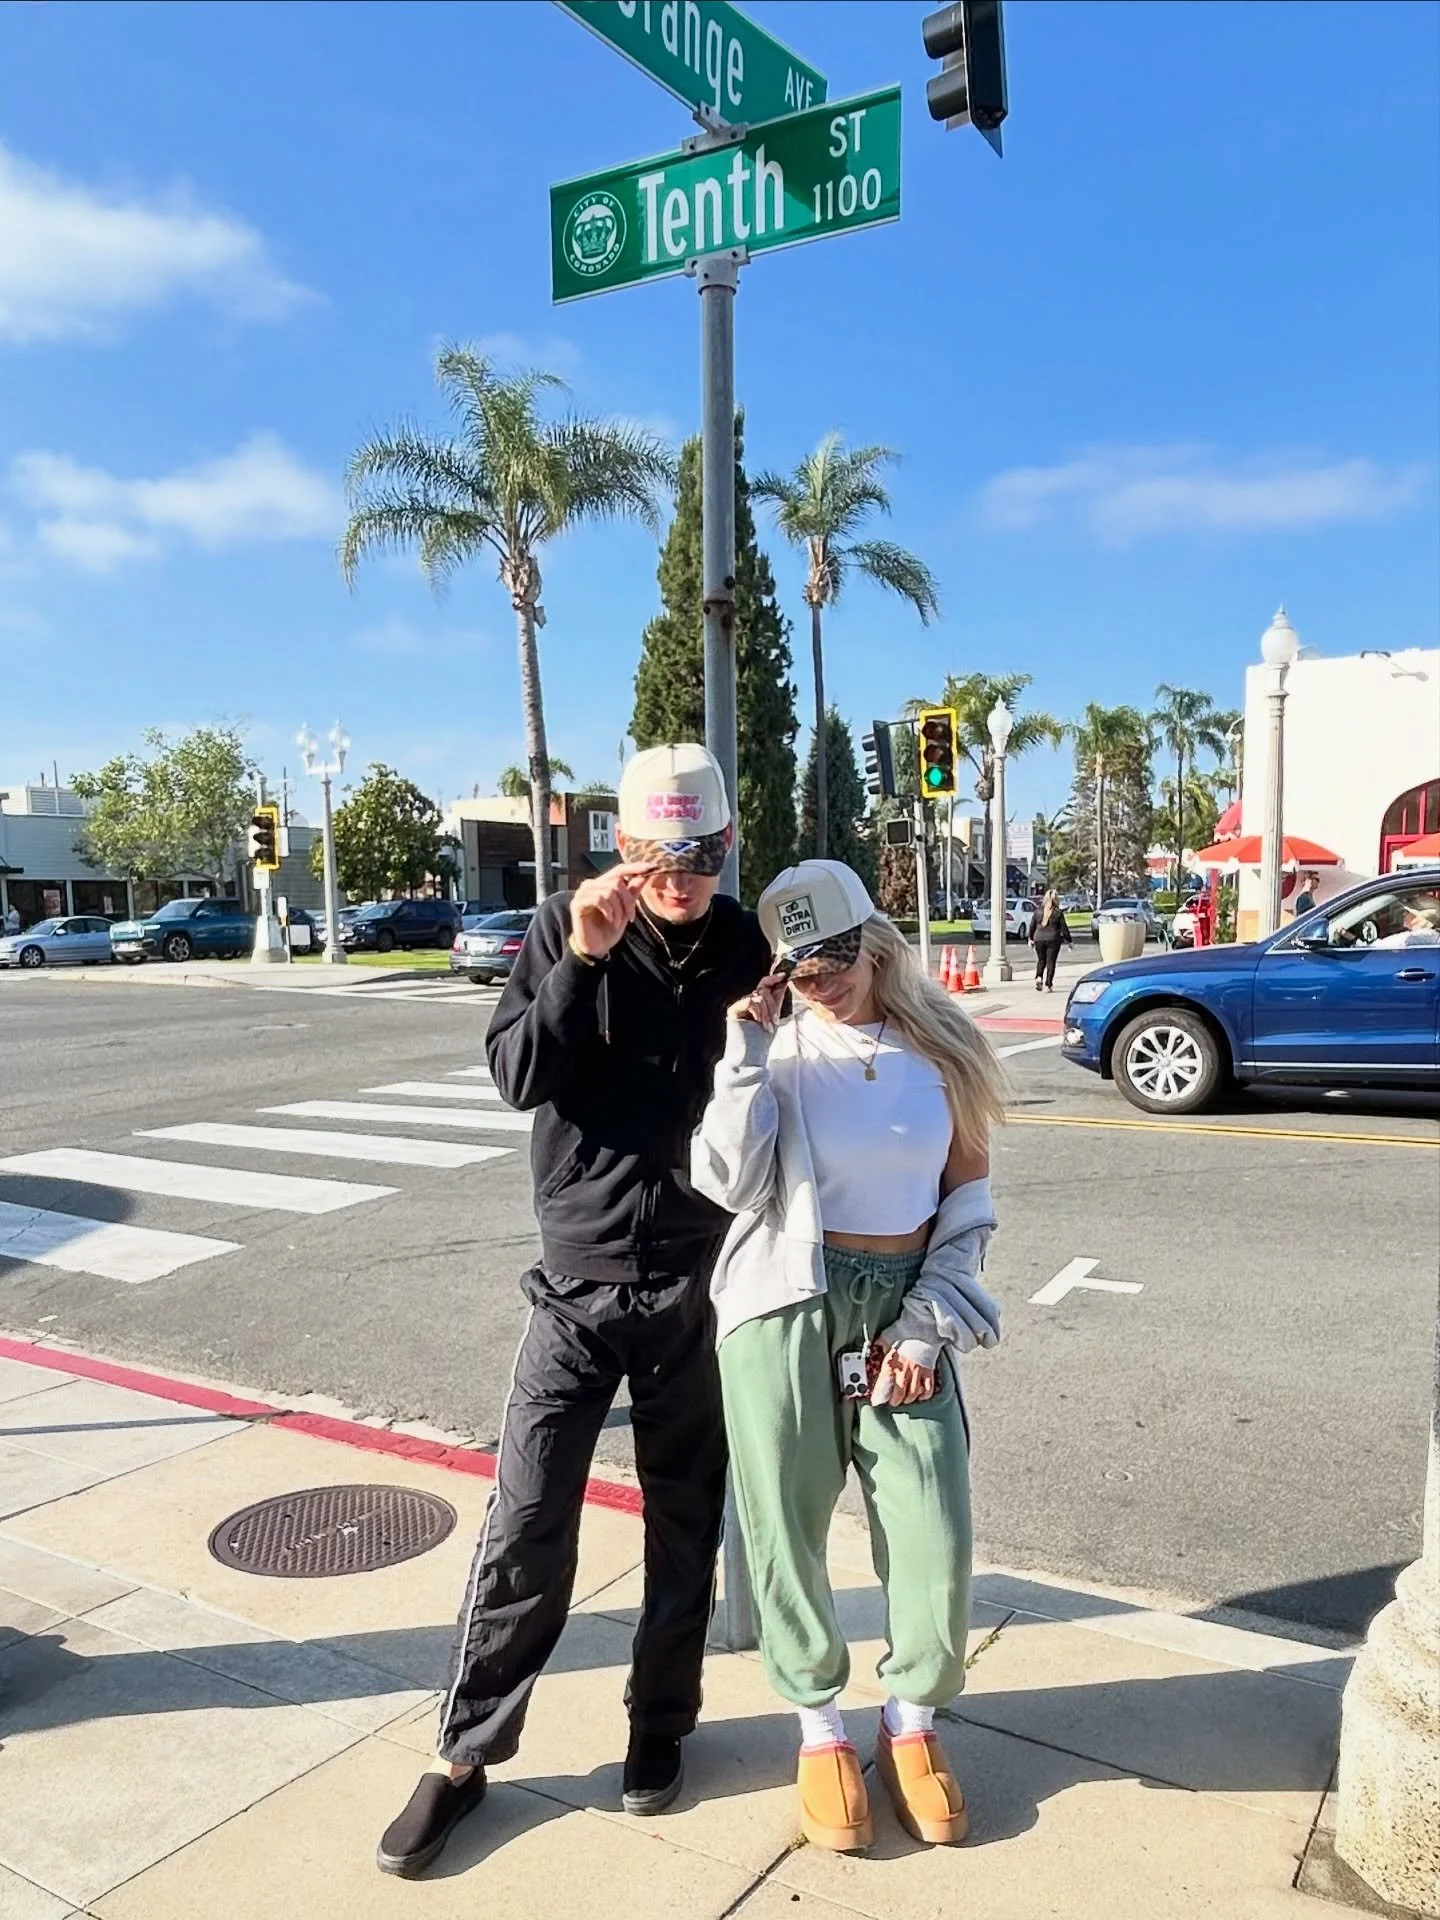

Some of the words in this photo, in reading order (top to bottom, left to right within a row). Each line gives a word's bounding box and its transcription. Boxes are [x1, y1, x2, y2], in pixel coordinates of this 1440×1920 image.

[617, 0, 744, 113] ange
[638, 143, 784, 263] Tenth
[828, 109, 867, 158] ST
[813, 167, 882, 223] 1100
[573, 195, 598, 218] CITY
[602, 196, 616, 208] OF
[569, 242, 620, 273] CORONADO
[782, 909, 811, 926] EXTRA
[785, 919, 812, 936] DIRTY
